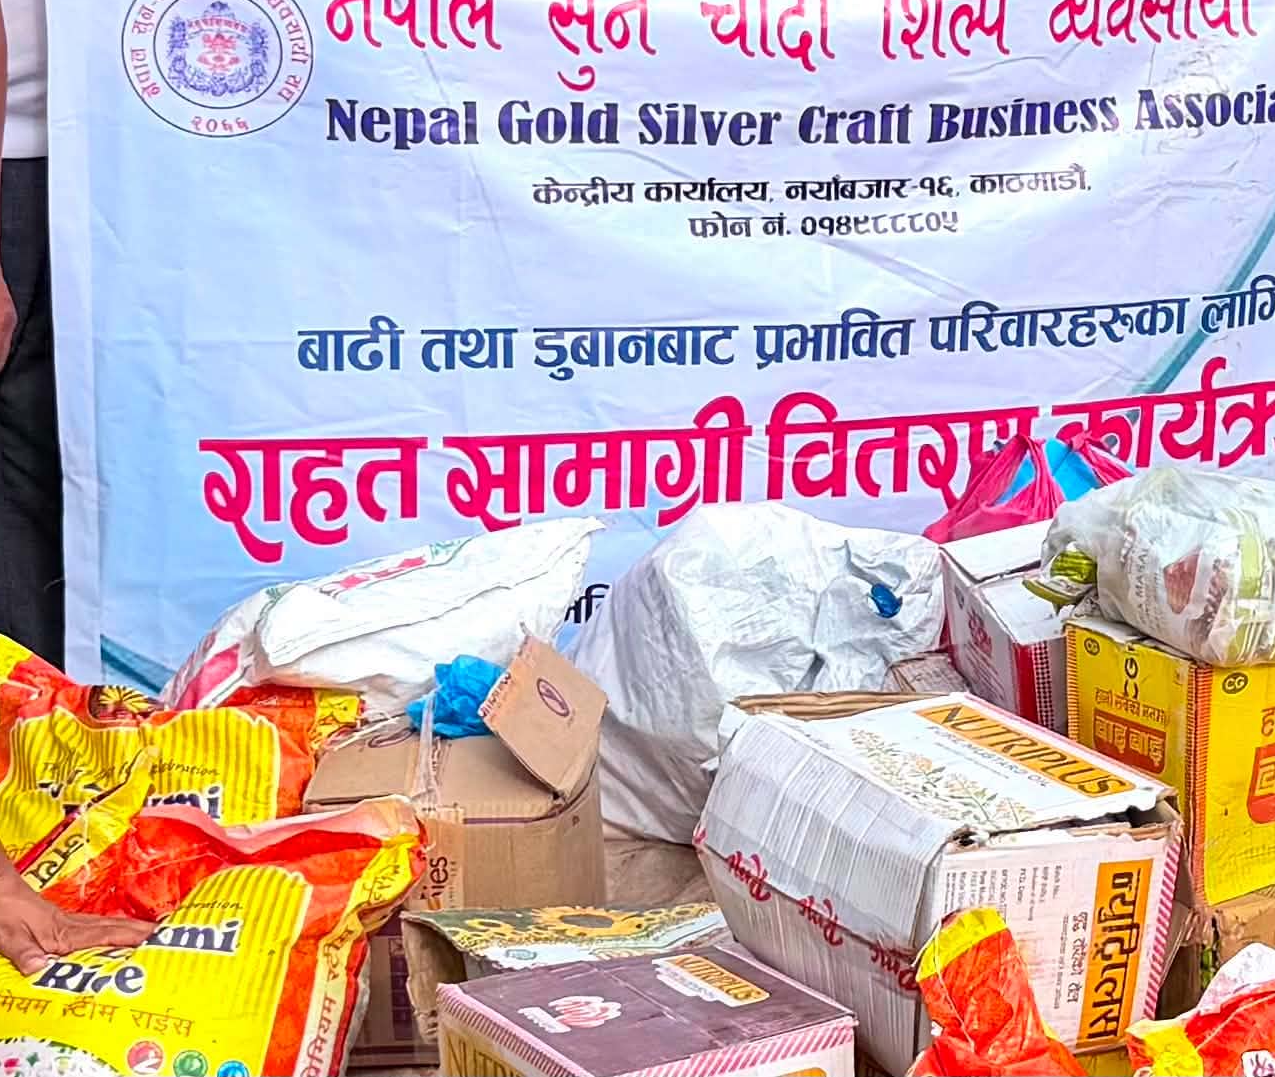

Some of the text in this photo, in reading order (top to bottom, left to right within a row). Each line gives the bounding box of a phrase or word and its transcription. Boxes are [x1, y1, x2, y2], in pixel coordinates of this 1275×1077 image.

[326, 99, 478, 150] Nepal
[498, 101, 618, 145] Gold
[638, 103, 781, 146] Silver
[799, 104, 912, 145] Craft
[927, 95, 1117, 143] Business
[532, 176, 635, 207] केन्द्रीय
[688, 210, 752, 238] फोन
[298, 316, 404, 372] बाढी
[421, 328, 518, 373] तथा
[533, 325, 738, 381] डुबानबाट
[754, 308, 916, 369] प्रभावित
[199, 437, 428, 564] राहत
[443, 396, 751, 532] सामाग्री
[1224, 674, 1247, 692] CG
[930, 705, 1126, 795] NUTRIPLUS
